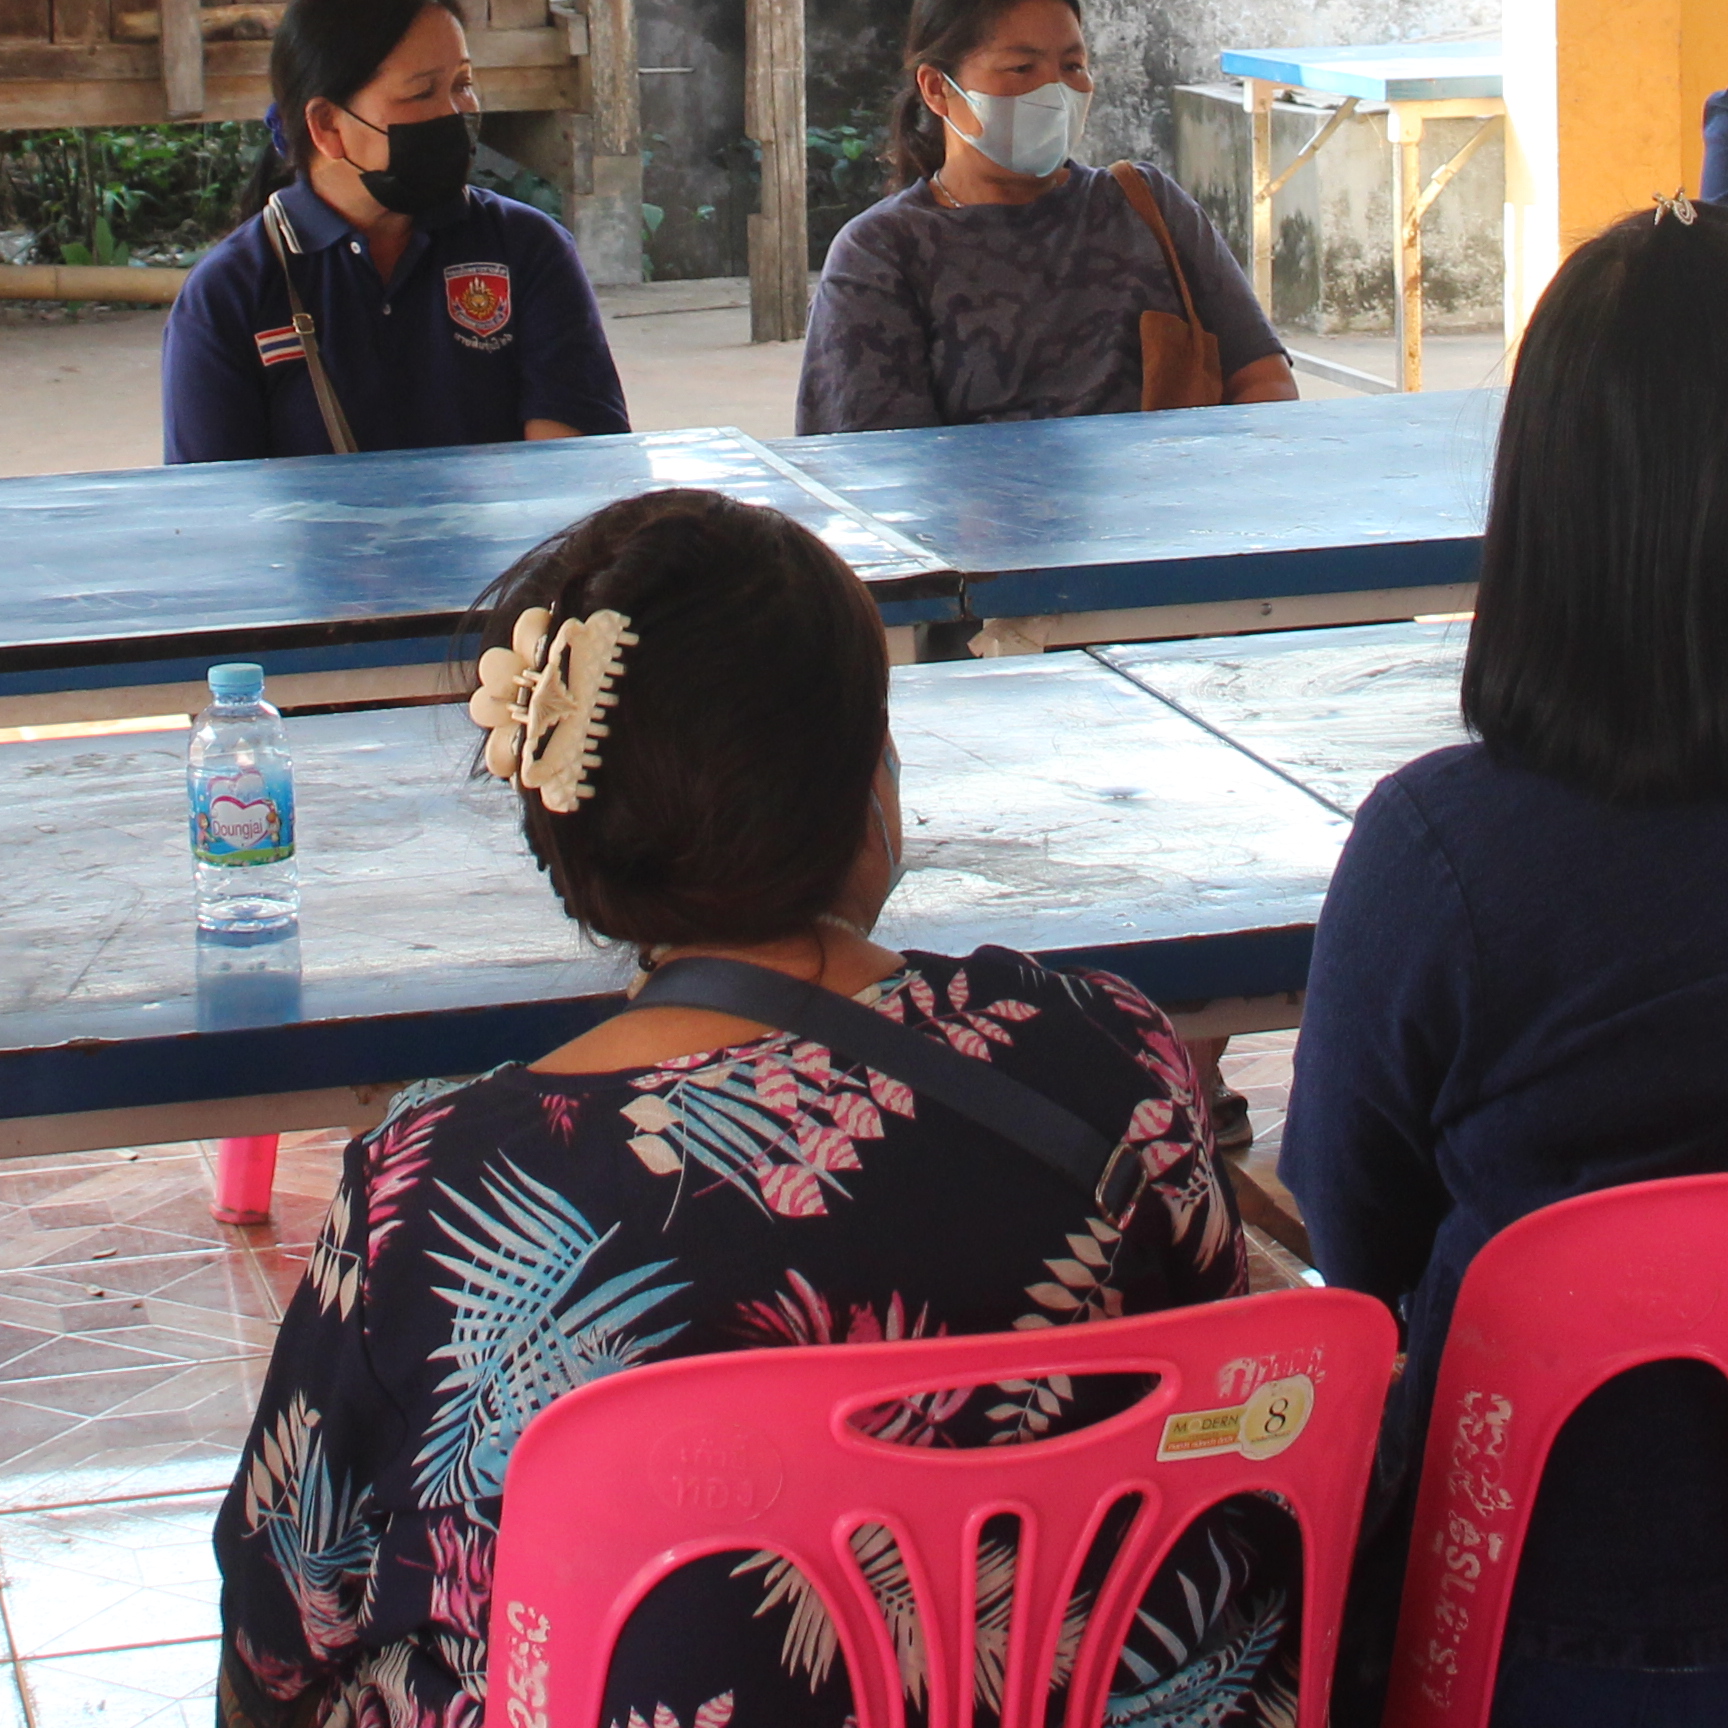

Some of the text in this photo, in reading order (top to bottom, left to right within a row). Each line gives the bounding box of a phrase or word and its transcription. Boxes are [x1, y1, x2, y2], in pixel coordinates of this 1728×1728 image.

[211, 819, 263, 840] Doungjai
[1173, 1414, 1239, 1433] MODERN
[1263, 1396, 1289, 1434] 8
